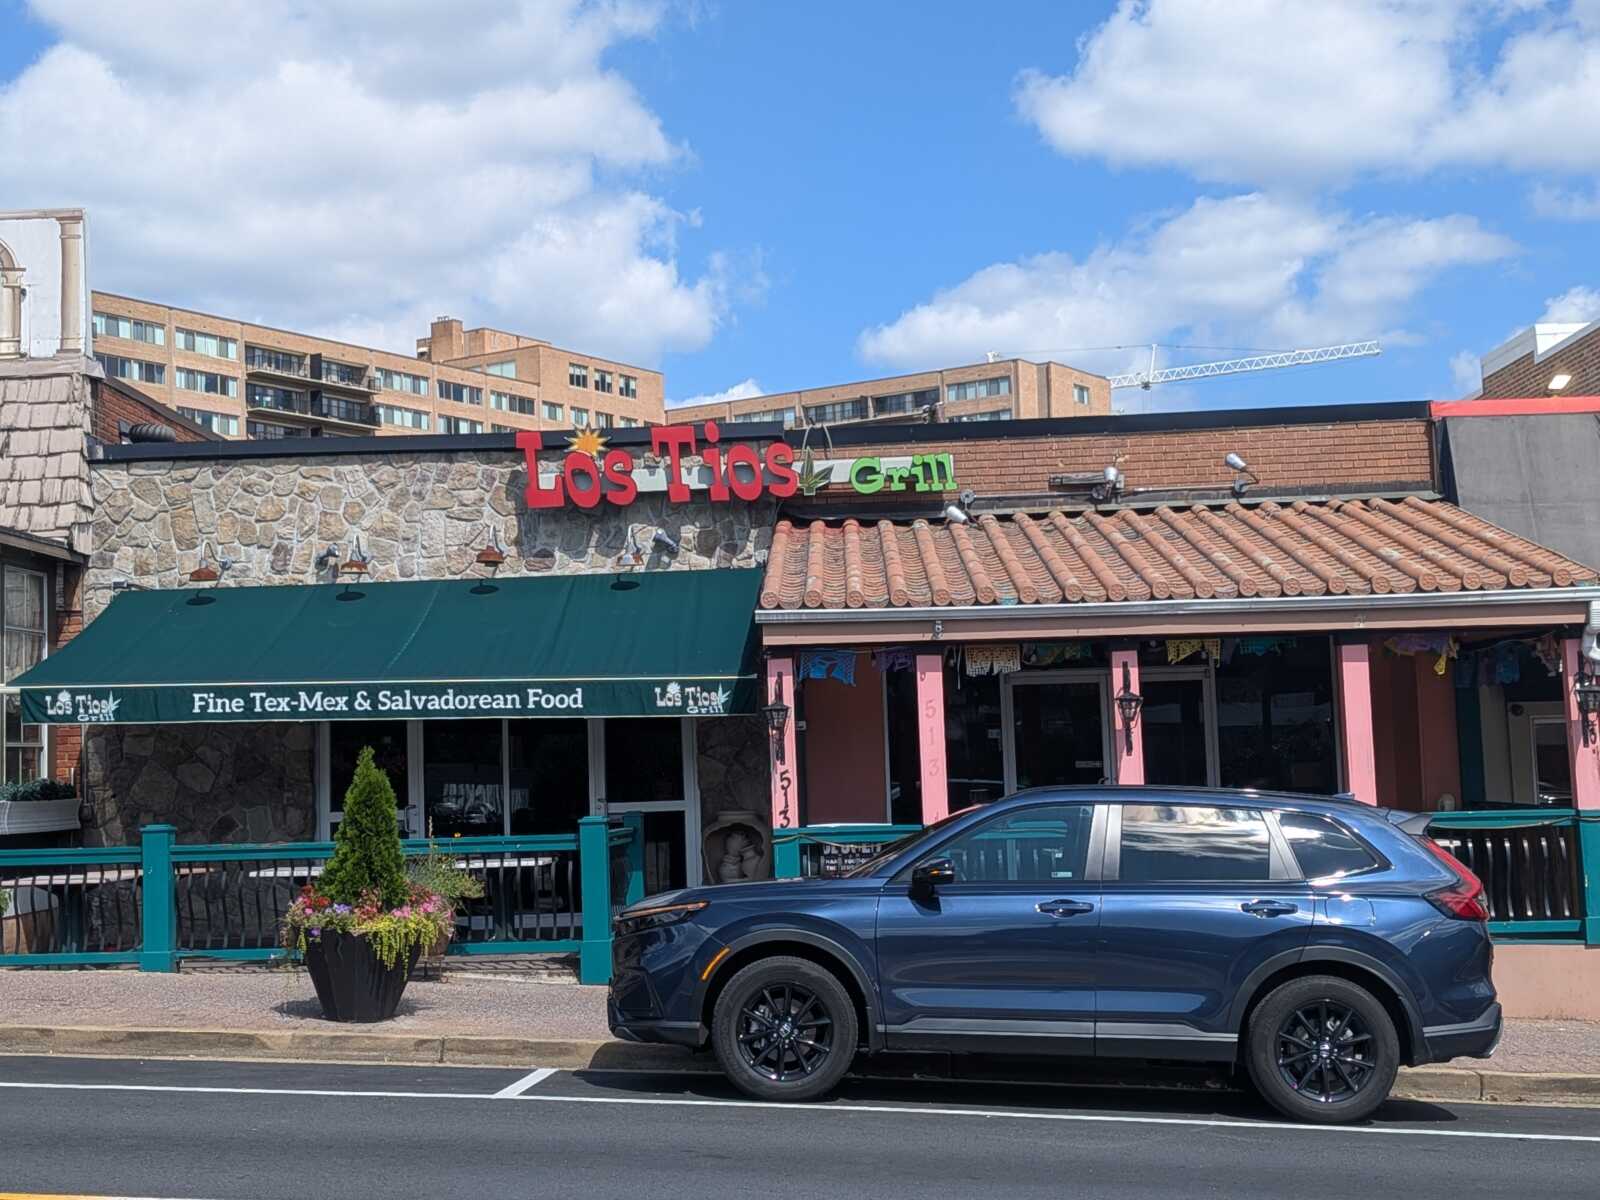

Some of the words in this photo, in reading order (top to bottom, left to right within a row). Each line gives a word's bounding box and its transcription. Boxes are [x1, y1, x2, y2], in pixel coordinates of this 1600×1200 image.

[516, 431, 637, 508] Los
[651, 421, 800, 502] Tios
[850, 452, 958, 494] Grill
[45, 695, 72, 715] Los
[75, 694, 109, 714] Tios
[192, 693, 244, 713] Fine
[250, 691, 349, 712] Tex-Mex
[353, 690, 372, 711] &
[377, 690, 522, 711] Salvadorean
[526, 688, 584, 709] Food
[655, 687, 682, 707] Los
[685, 686, 718, 706] Tios
[77, 713, 115, 721] Grill
[686, 705, 724, 714] Grill
